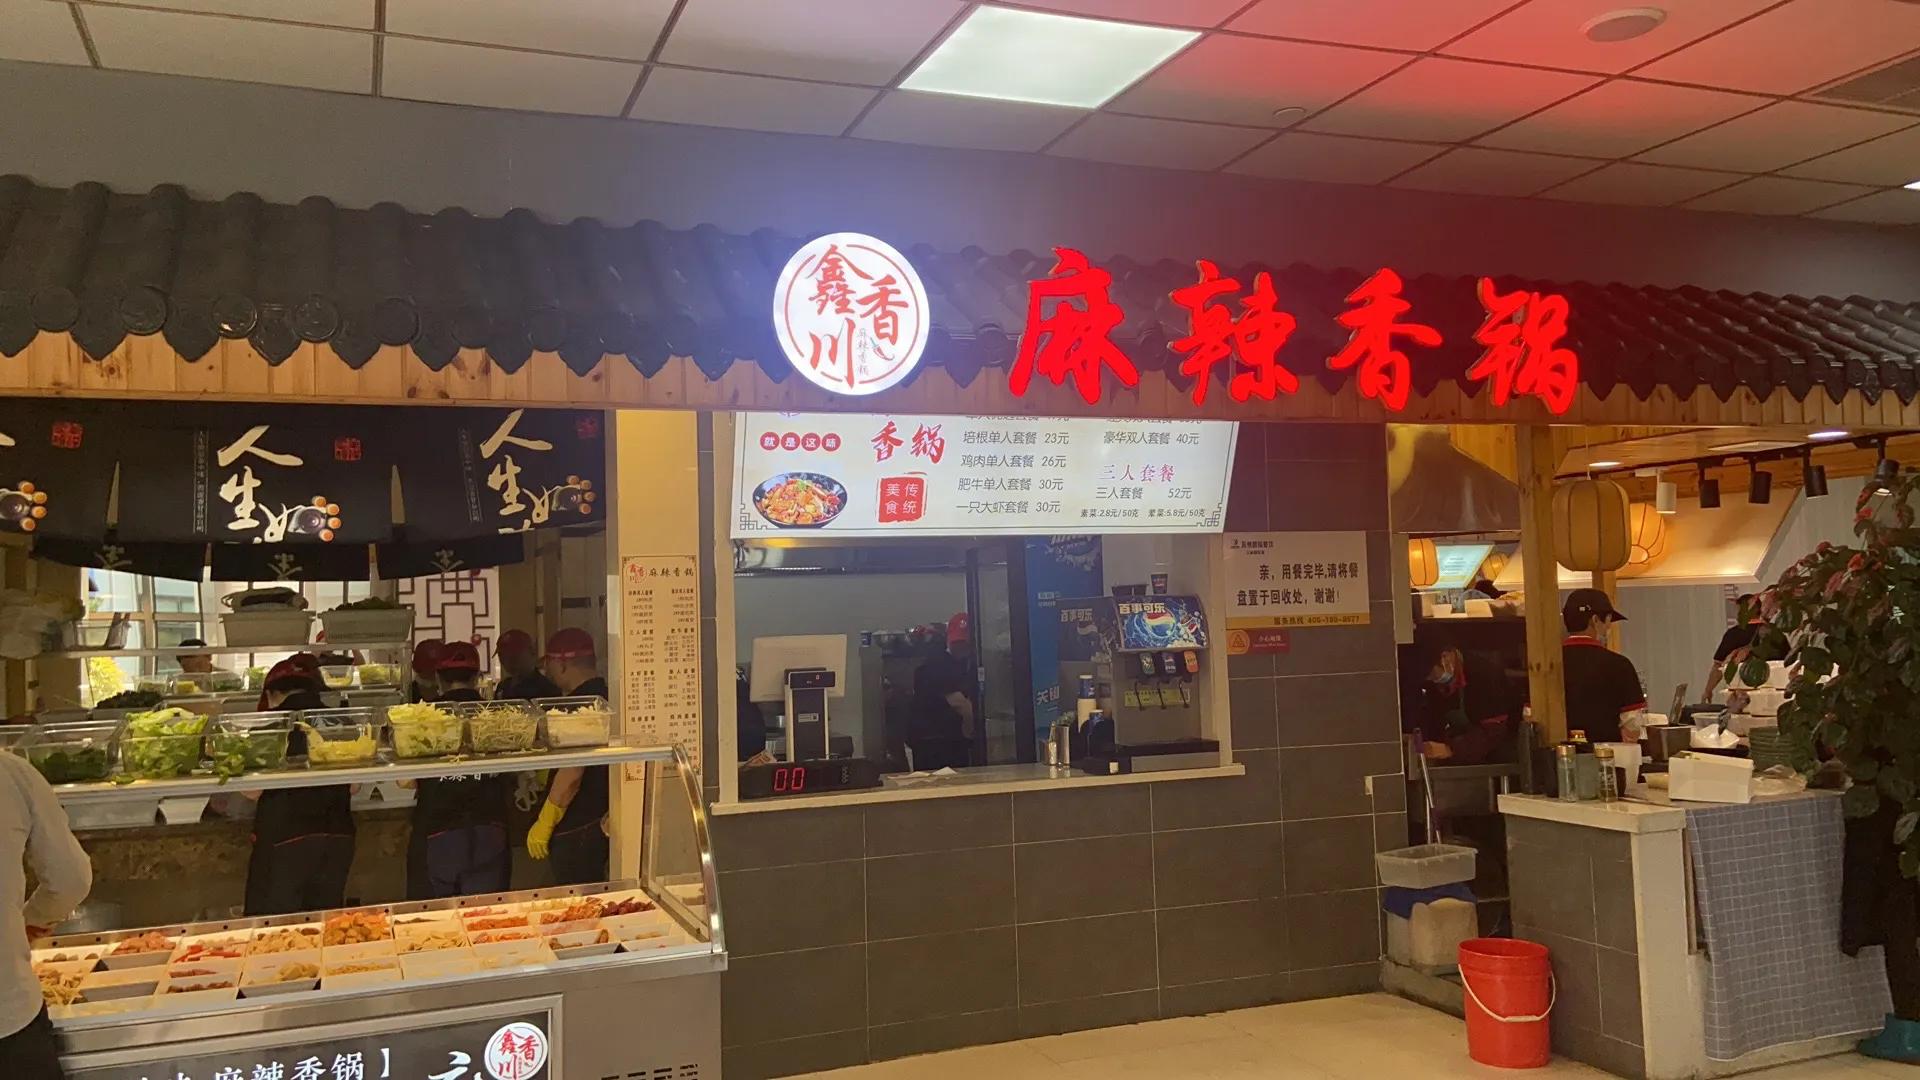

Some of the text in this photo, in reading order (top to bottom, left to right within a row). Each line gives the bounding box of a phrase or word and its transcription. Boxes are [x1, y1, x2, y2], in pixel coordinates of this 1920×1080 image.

[1008, 246, 1580, 416] 麻辣香锅
[760, 431, 842, 451] 就是这味
[871, 420, 946, 464] 香锅
[963, 430, 1069, 445] 培根单人套餐 23元
[1104, 431, 1200, 445] 豪华双人套餐 40元
[961, 454, 1066, 468] 鸡肉单人套餐 26元
[1100, 464, 1175, 482] 三人套餐
[958, 477, 1064, 491] 肥牛单人套餐 30元
[1096, 487, 1192, 499] 三人套餐 52元
[956, 501, 1061, 514] 一只大虾套餐 30元
[1060, 608, 1093, 622] 百事可乐
[1118, 602, 1166, 614] 百事可乐
